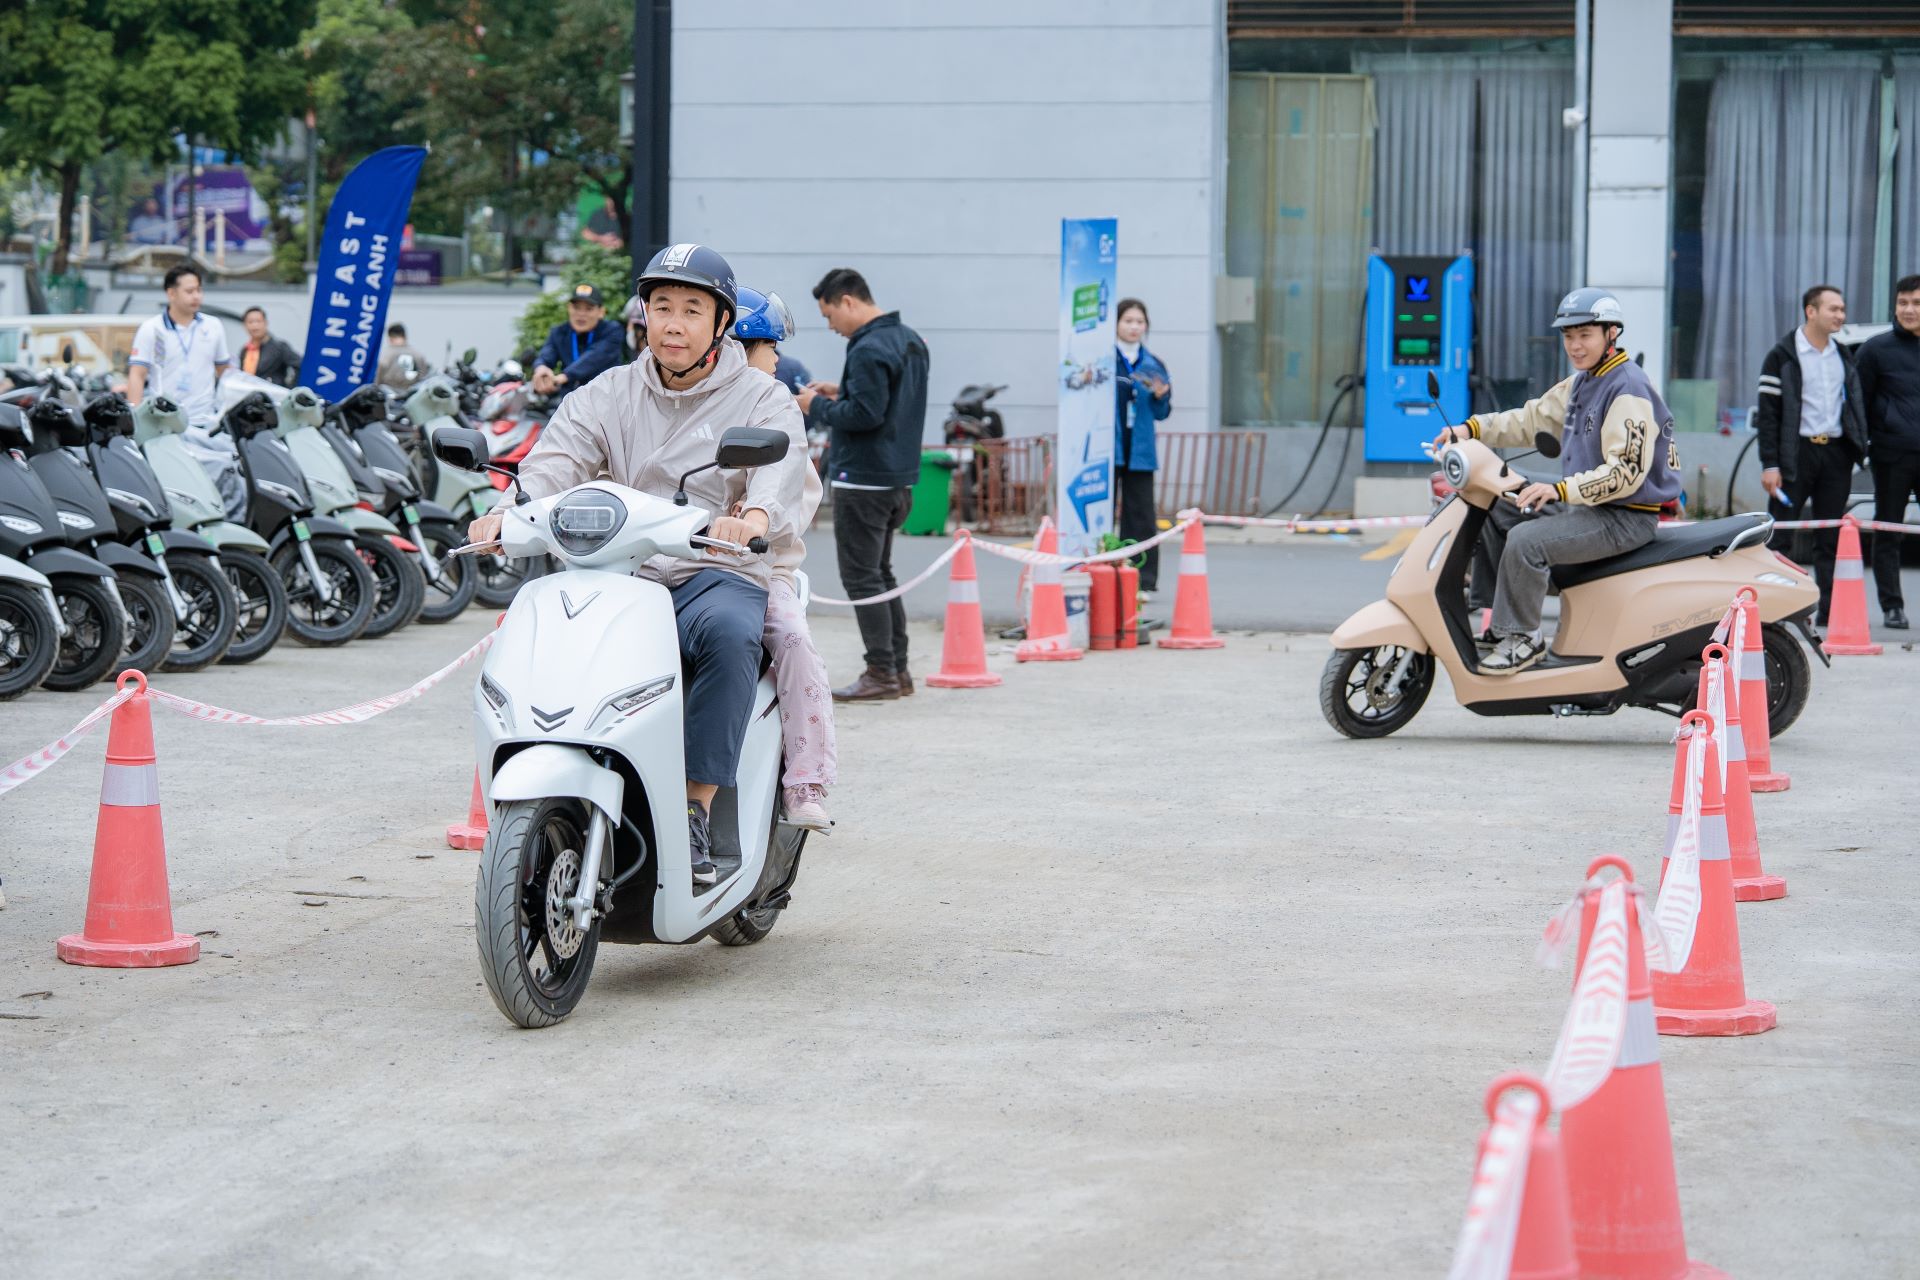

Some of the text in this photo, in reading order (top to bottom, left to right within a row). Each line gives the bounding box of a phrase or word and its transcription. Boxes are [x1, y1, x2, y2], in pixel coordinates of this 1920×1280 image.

[316, 211, 366, 386] VINFAST
[347, 234, 389, 385] HOÀNG ANH
